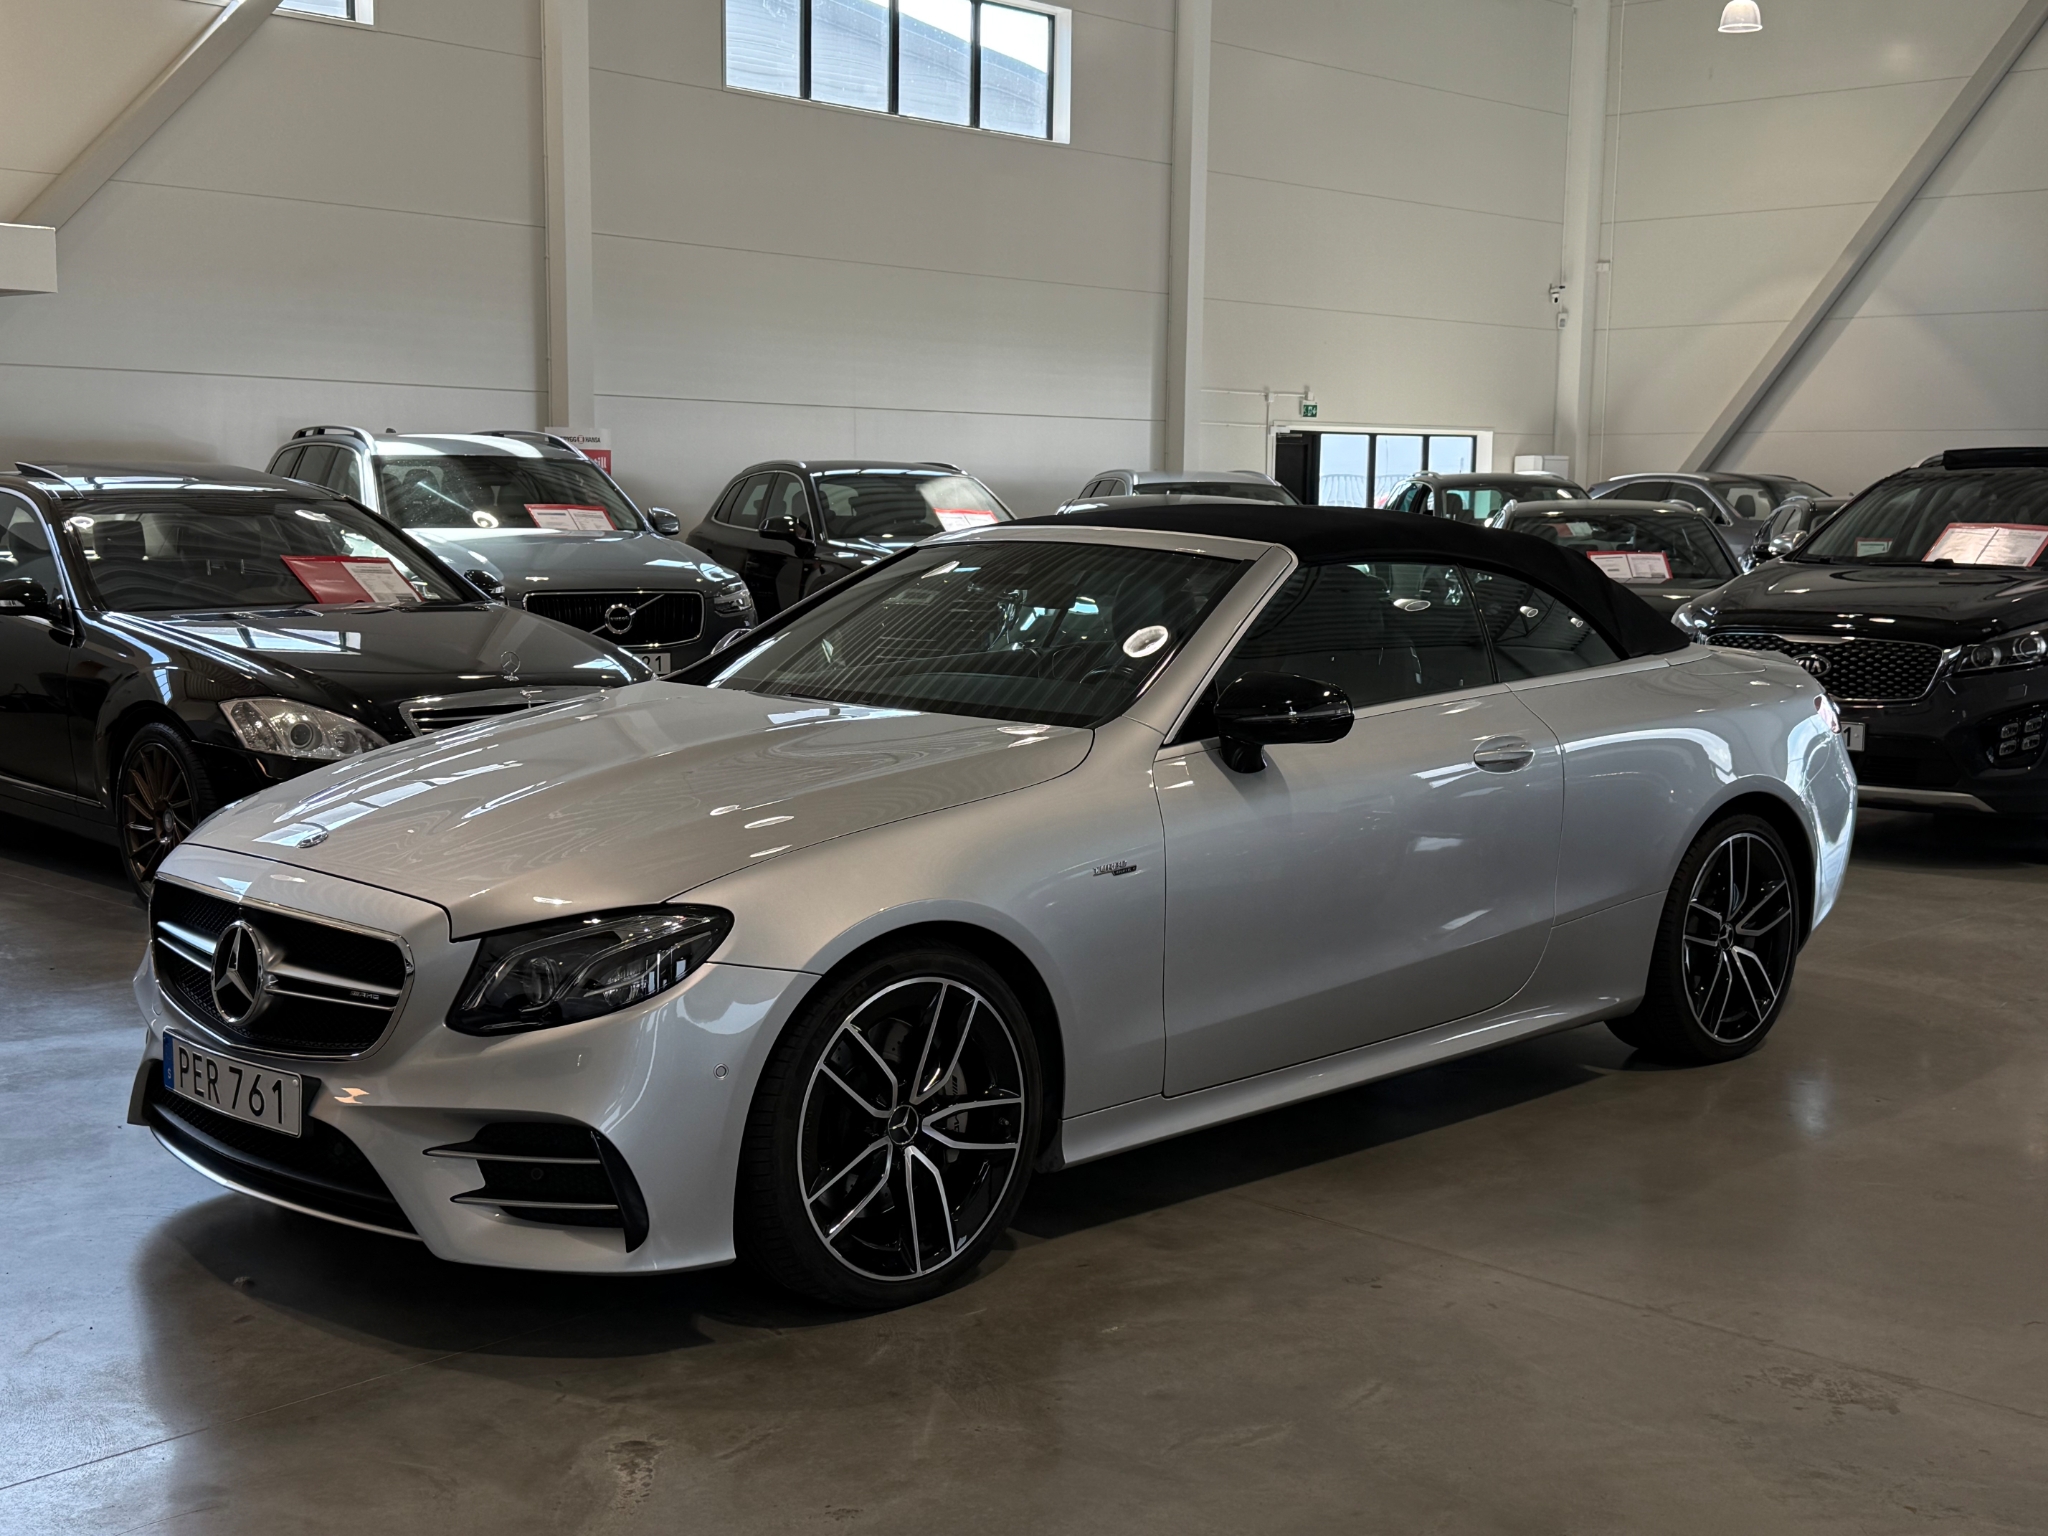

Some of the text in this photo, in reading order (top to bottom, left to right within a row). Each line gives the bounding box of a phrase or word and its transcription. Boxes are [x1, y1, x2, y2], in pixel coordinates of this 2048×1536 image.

[166, 1068, 172, 1079] S
[178, 1046, 283, 1125] PER 761
